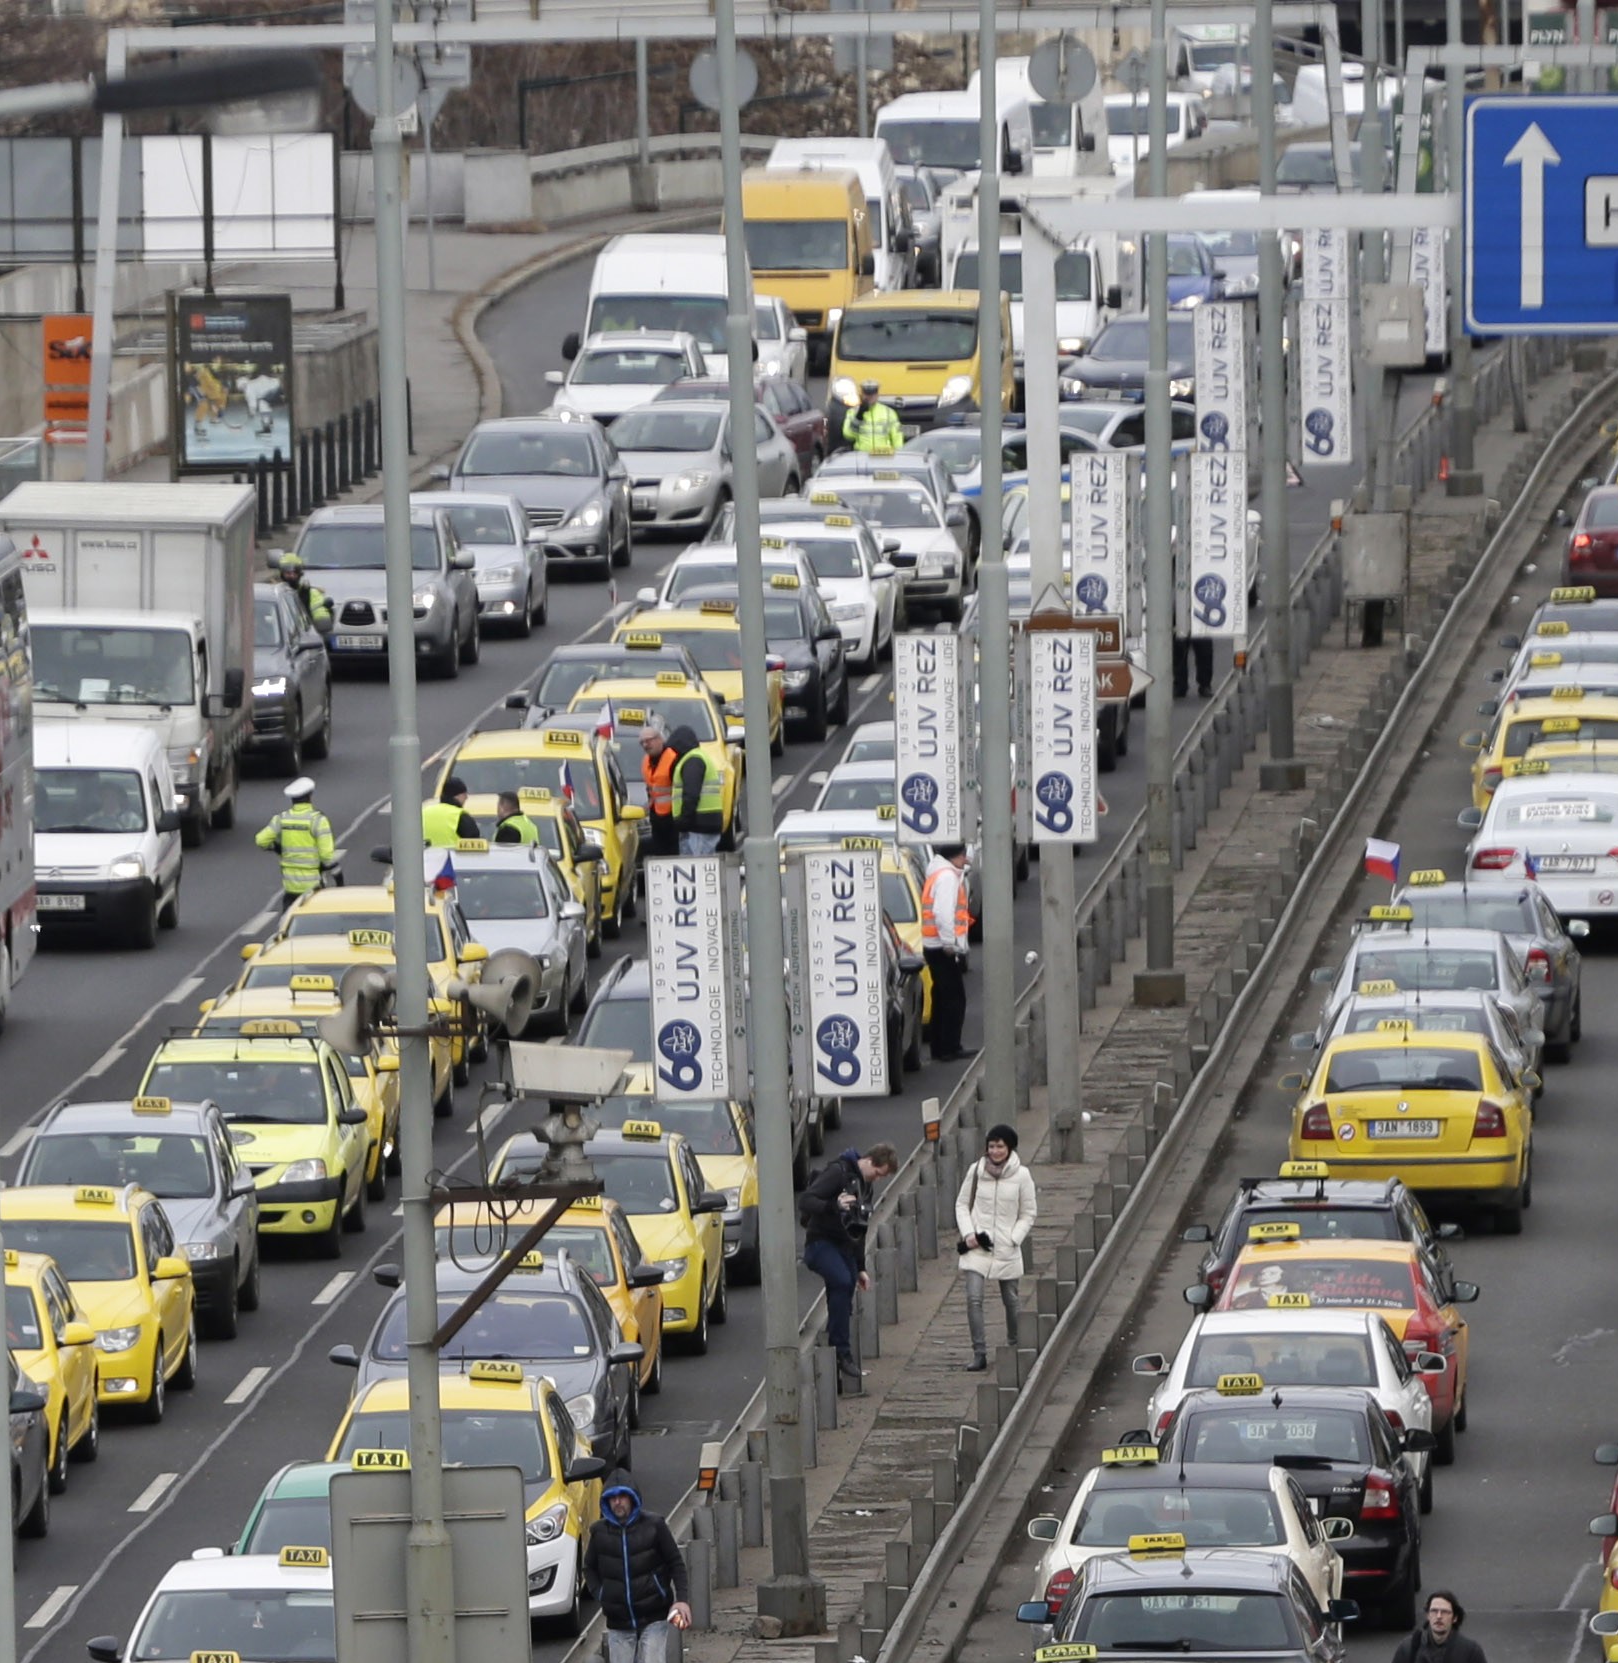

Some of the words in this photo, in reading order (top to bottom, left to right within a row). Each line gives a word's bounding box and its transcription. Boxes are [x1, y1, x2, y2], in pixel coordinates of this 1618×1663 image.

[550, 732, 579, 743] TAXI
[703, 863, 717, 896] LIDÉ
[860, 858, 875, 891] LIDÉ
[666, 864, 698, 928] ŘEŽ
[824, 858, 855, 923] ŘEŽ
[354, 931, 386, 945] TAXI
[706, 908, 720, 972] INOVACE
[864, 903, 877, 967] INOVACE
[670, 941, 700, 1003] ÚJV
[829, 936, 859, 997] ÚJV
[1367, 982, 1390, 992] TAXI
[253, 1022, 288, 1033] TAXI
[1384, 1020, 1408, 1029] TAXI
[709, 985, 724, 1091] TECHNOLOGIE
[867, 980, 882, 1087] TECHNOLOGIE
[629, 1124, 655, 1134] TAXI
[1377, 1120, 1398, 1133] 3AN
[1407, 1120, 1434, 1133] 1899
[82, 1189, 108, 1199] TAXI
[1277, 1295, 1304, 1304] TAXI
[480, 1362, 515, 1372] TAXI
[1224, 1377, 1256, 1388] TAXI
[361, 1452, 402, 1466] TAXI
[1113, 1448, 1146, 1458] TAXI
[288, 1550, 320, 1562] TAXI
